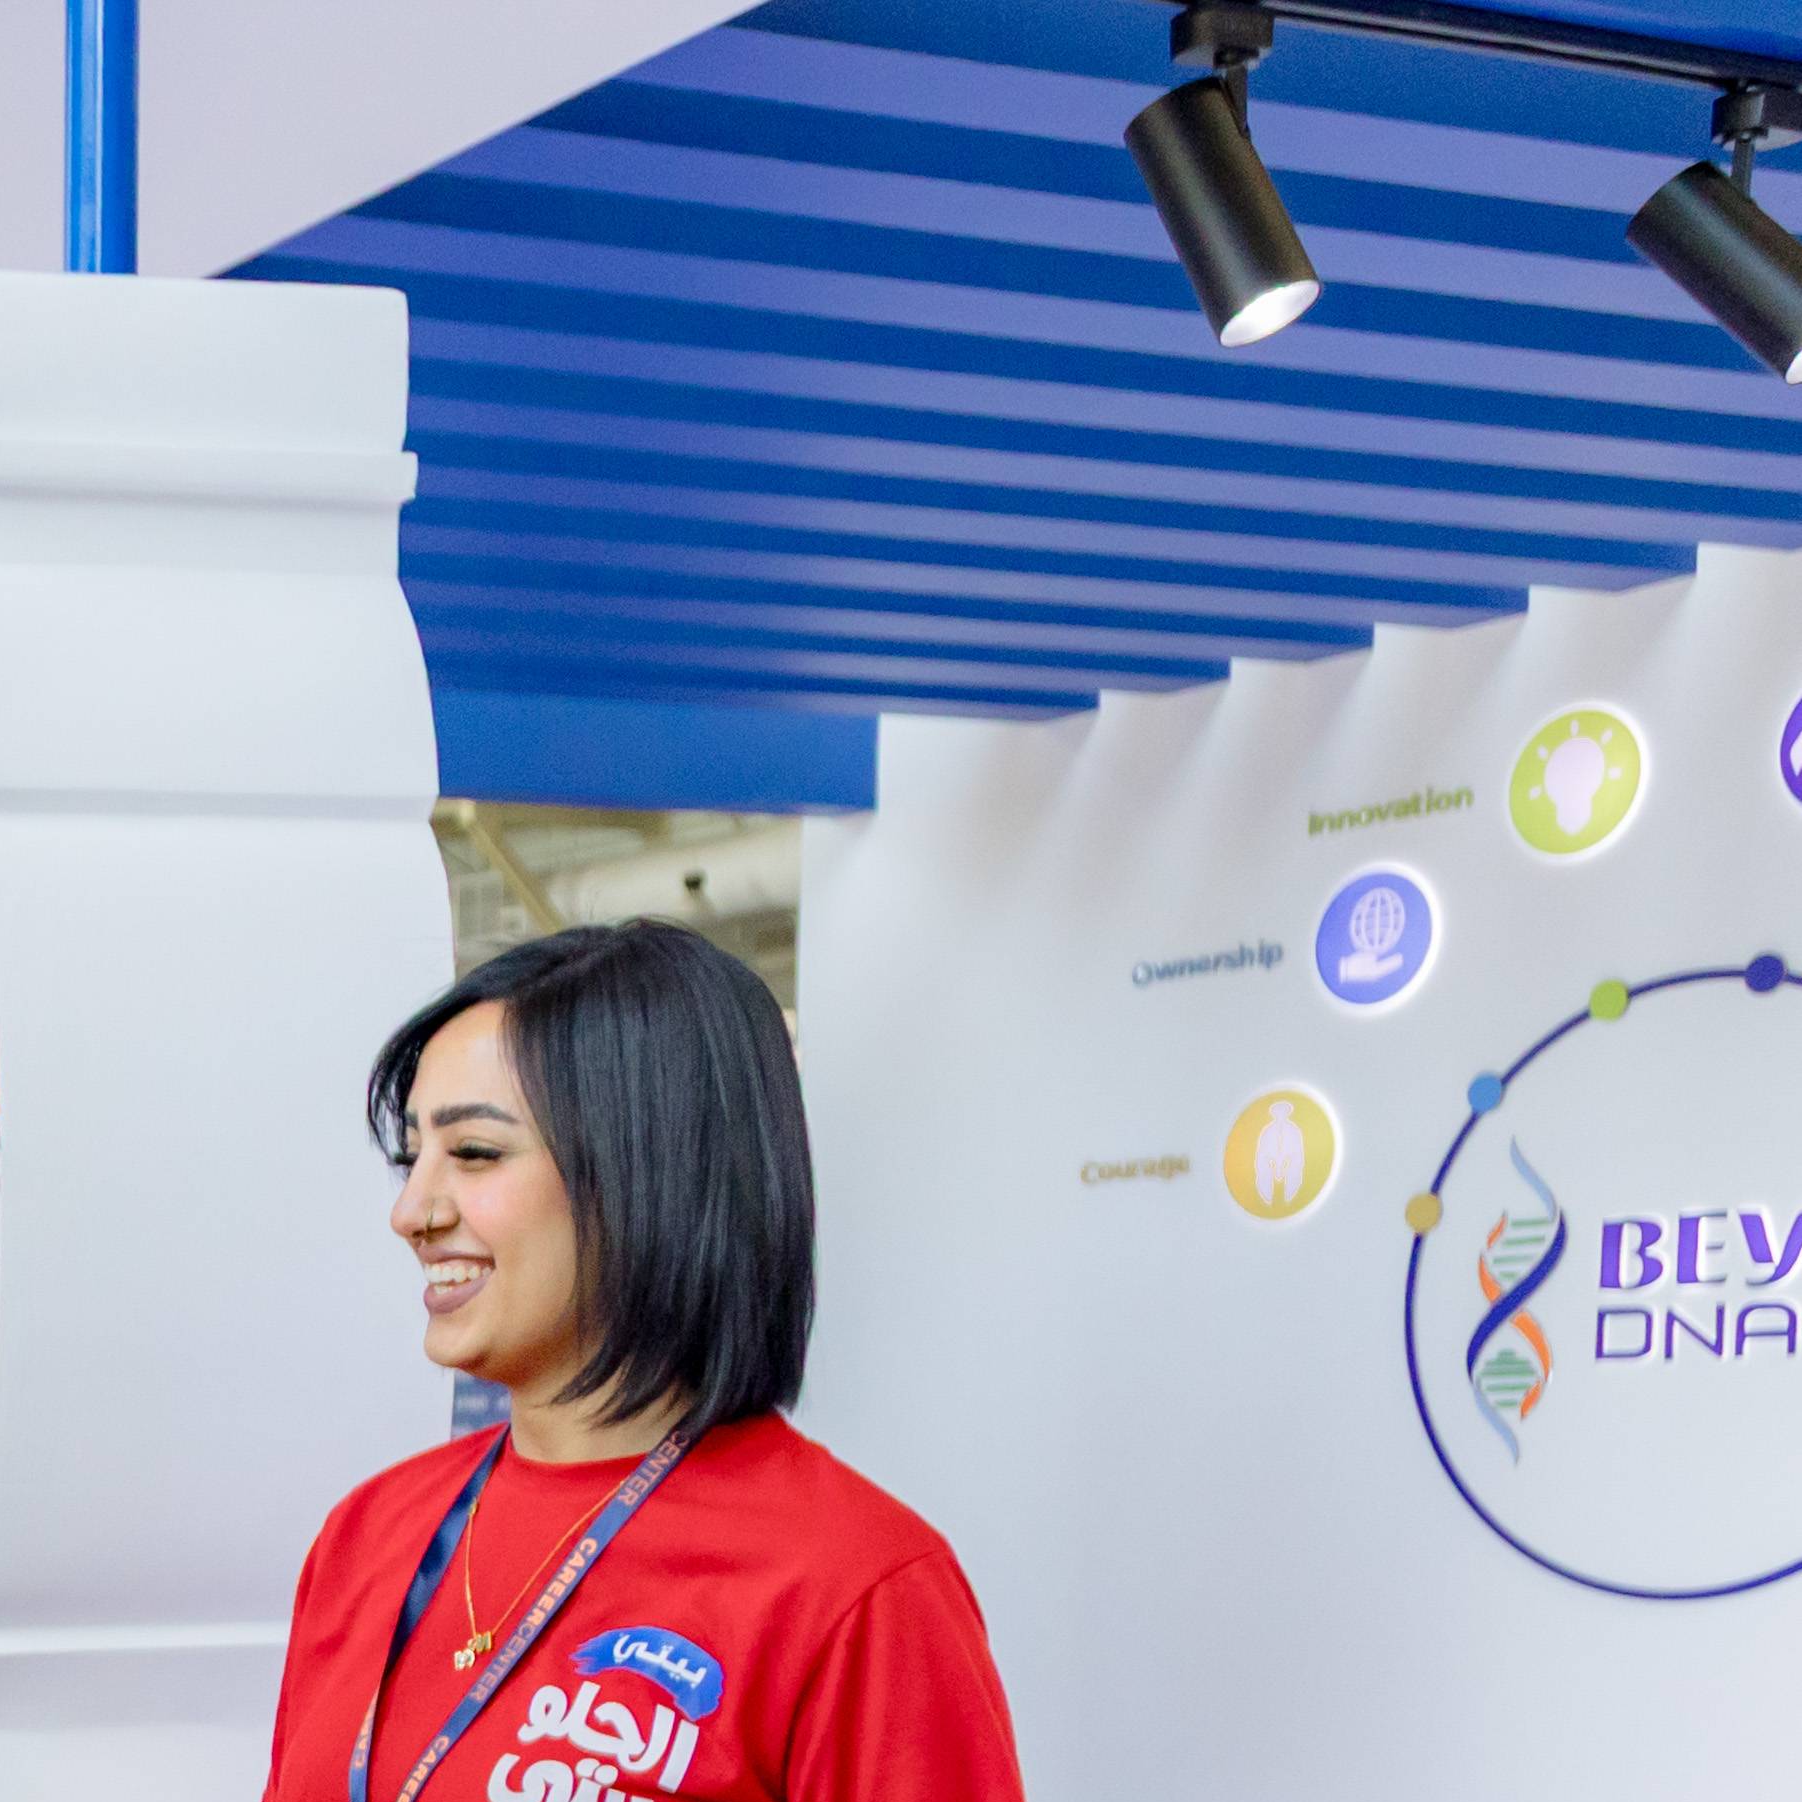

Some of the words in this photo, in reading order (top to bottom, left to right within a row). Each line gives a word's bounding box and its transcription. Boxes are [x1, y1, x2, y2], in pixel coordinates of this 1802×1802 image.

[1308, 785, 1475, 836] Innovation
[1131, 939, 1284, 989] Ownership
[1595, 1300, 1799, 1361] DNA
[612, 1631, 707, 1690] بيتي
[518, 1681, 700, 1794] الحلو
